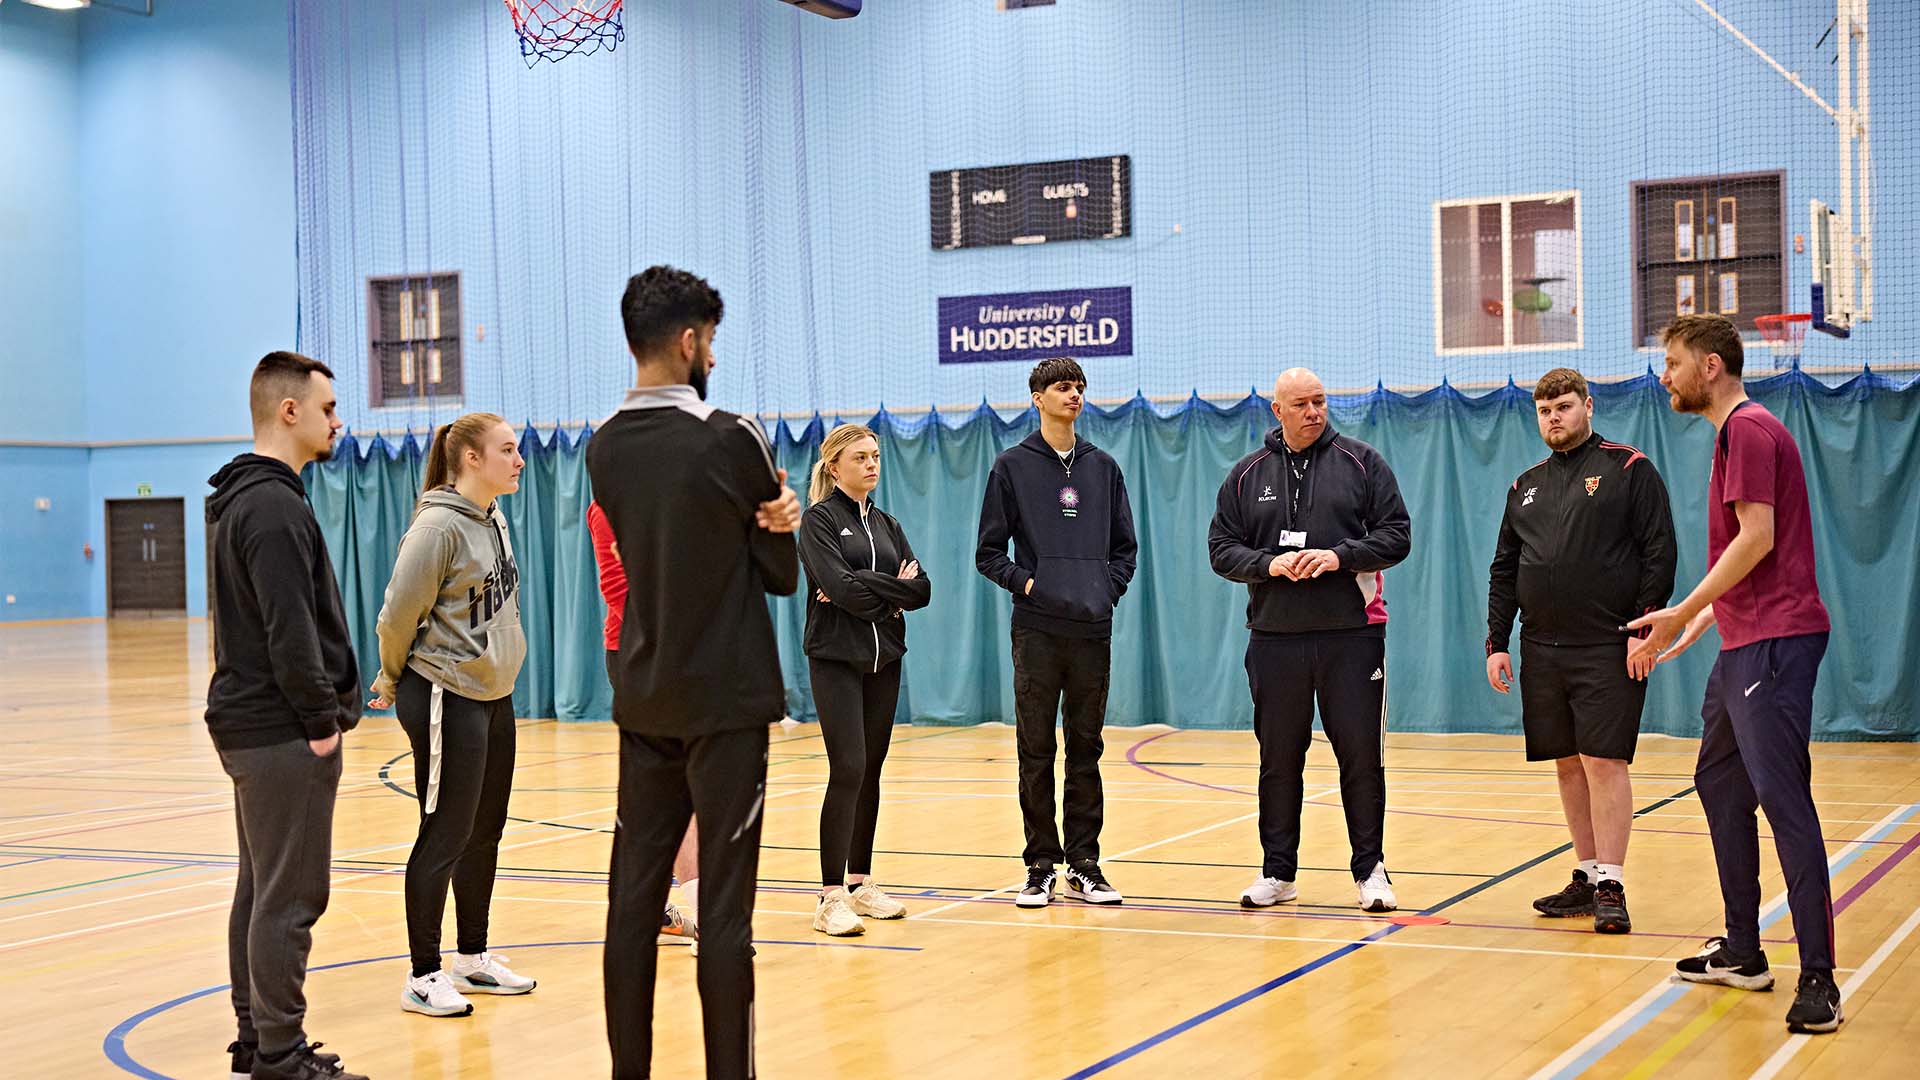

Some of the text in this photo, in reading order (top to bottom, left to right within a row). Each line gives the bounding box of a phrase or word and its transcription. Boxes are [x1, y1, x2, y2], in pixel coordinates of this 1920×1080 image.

[971, 189, 1007, 205] HOME
[1043, 182, 1089, 199] GUESTS
[978, 300, 1092, 325] University of
[950, 318, 1119, 353] HUDDERSFIELD
[1524, 487, 1538, 497] JE
